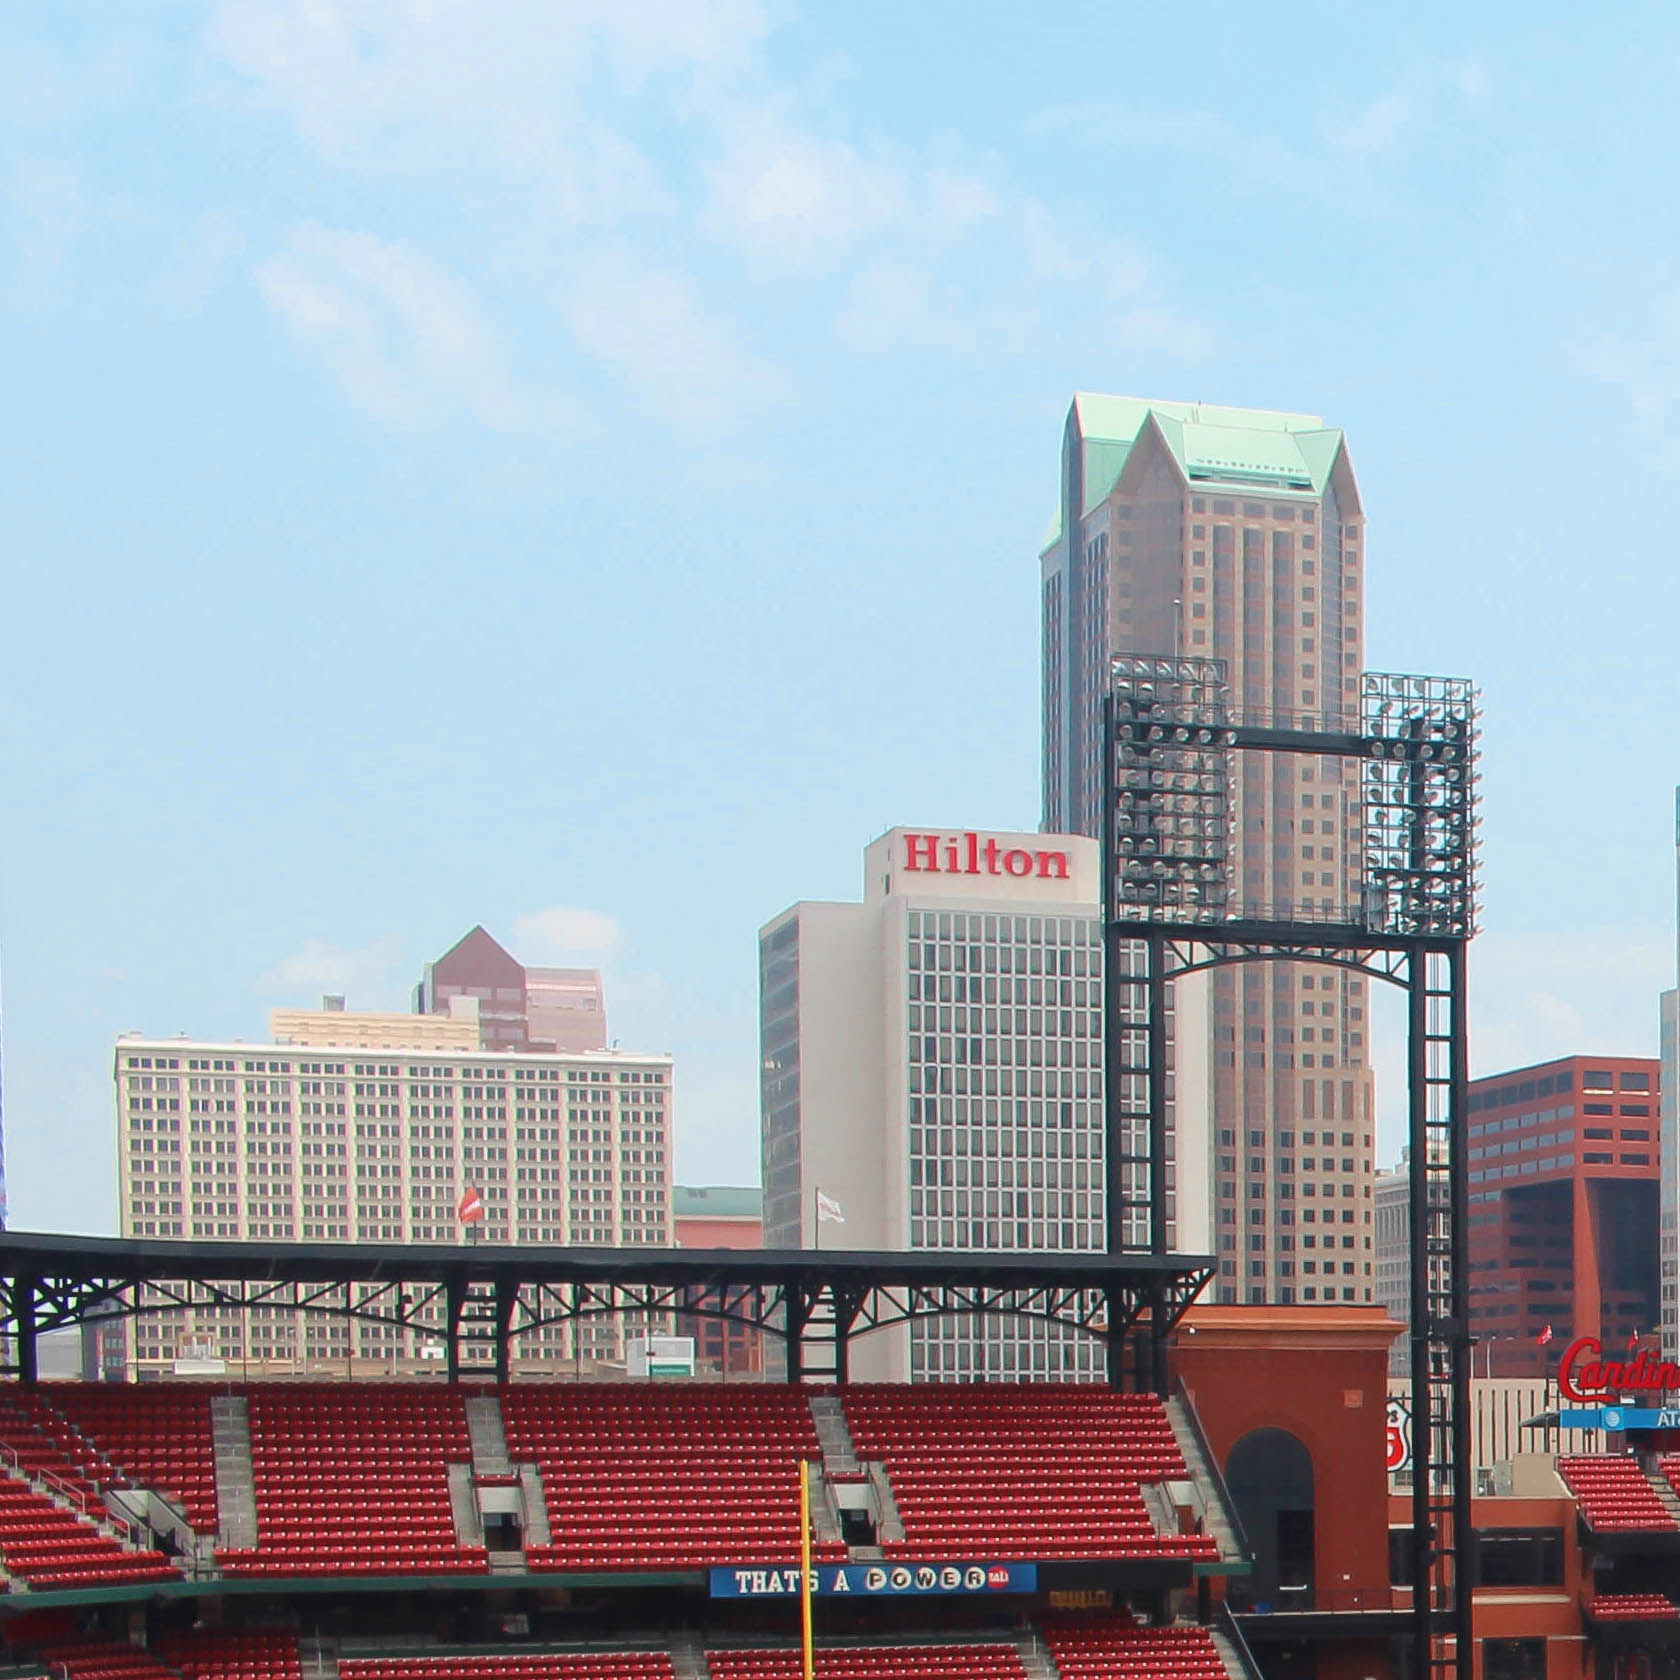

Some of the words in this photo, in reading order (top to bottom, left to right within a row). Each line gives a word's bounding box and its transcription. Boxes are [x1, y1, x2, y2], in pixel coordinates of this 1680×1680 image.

[903, 832, 1070, 879] Hilton
[735, 1569, 819, 1593] THAT'S
[833, 1569, 850, 1592] A
[867, 1567, 985, 1589] POWER
